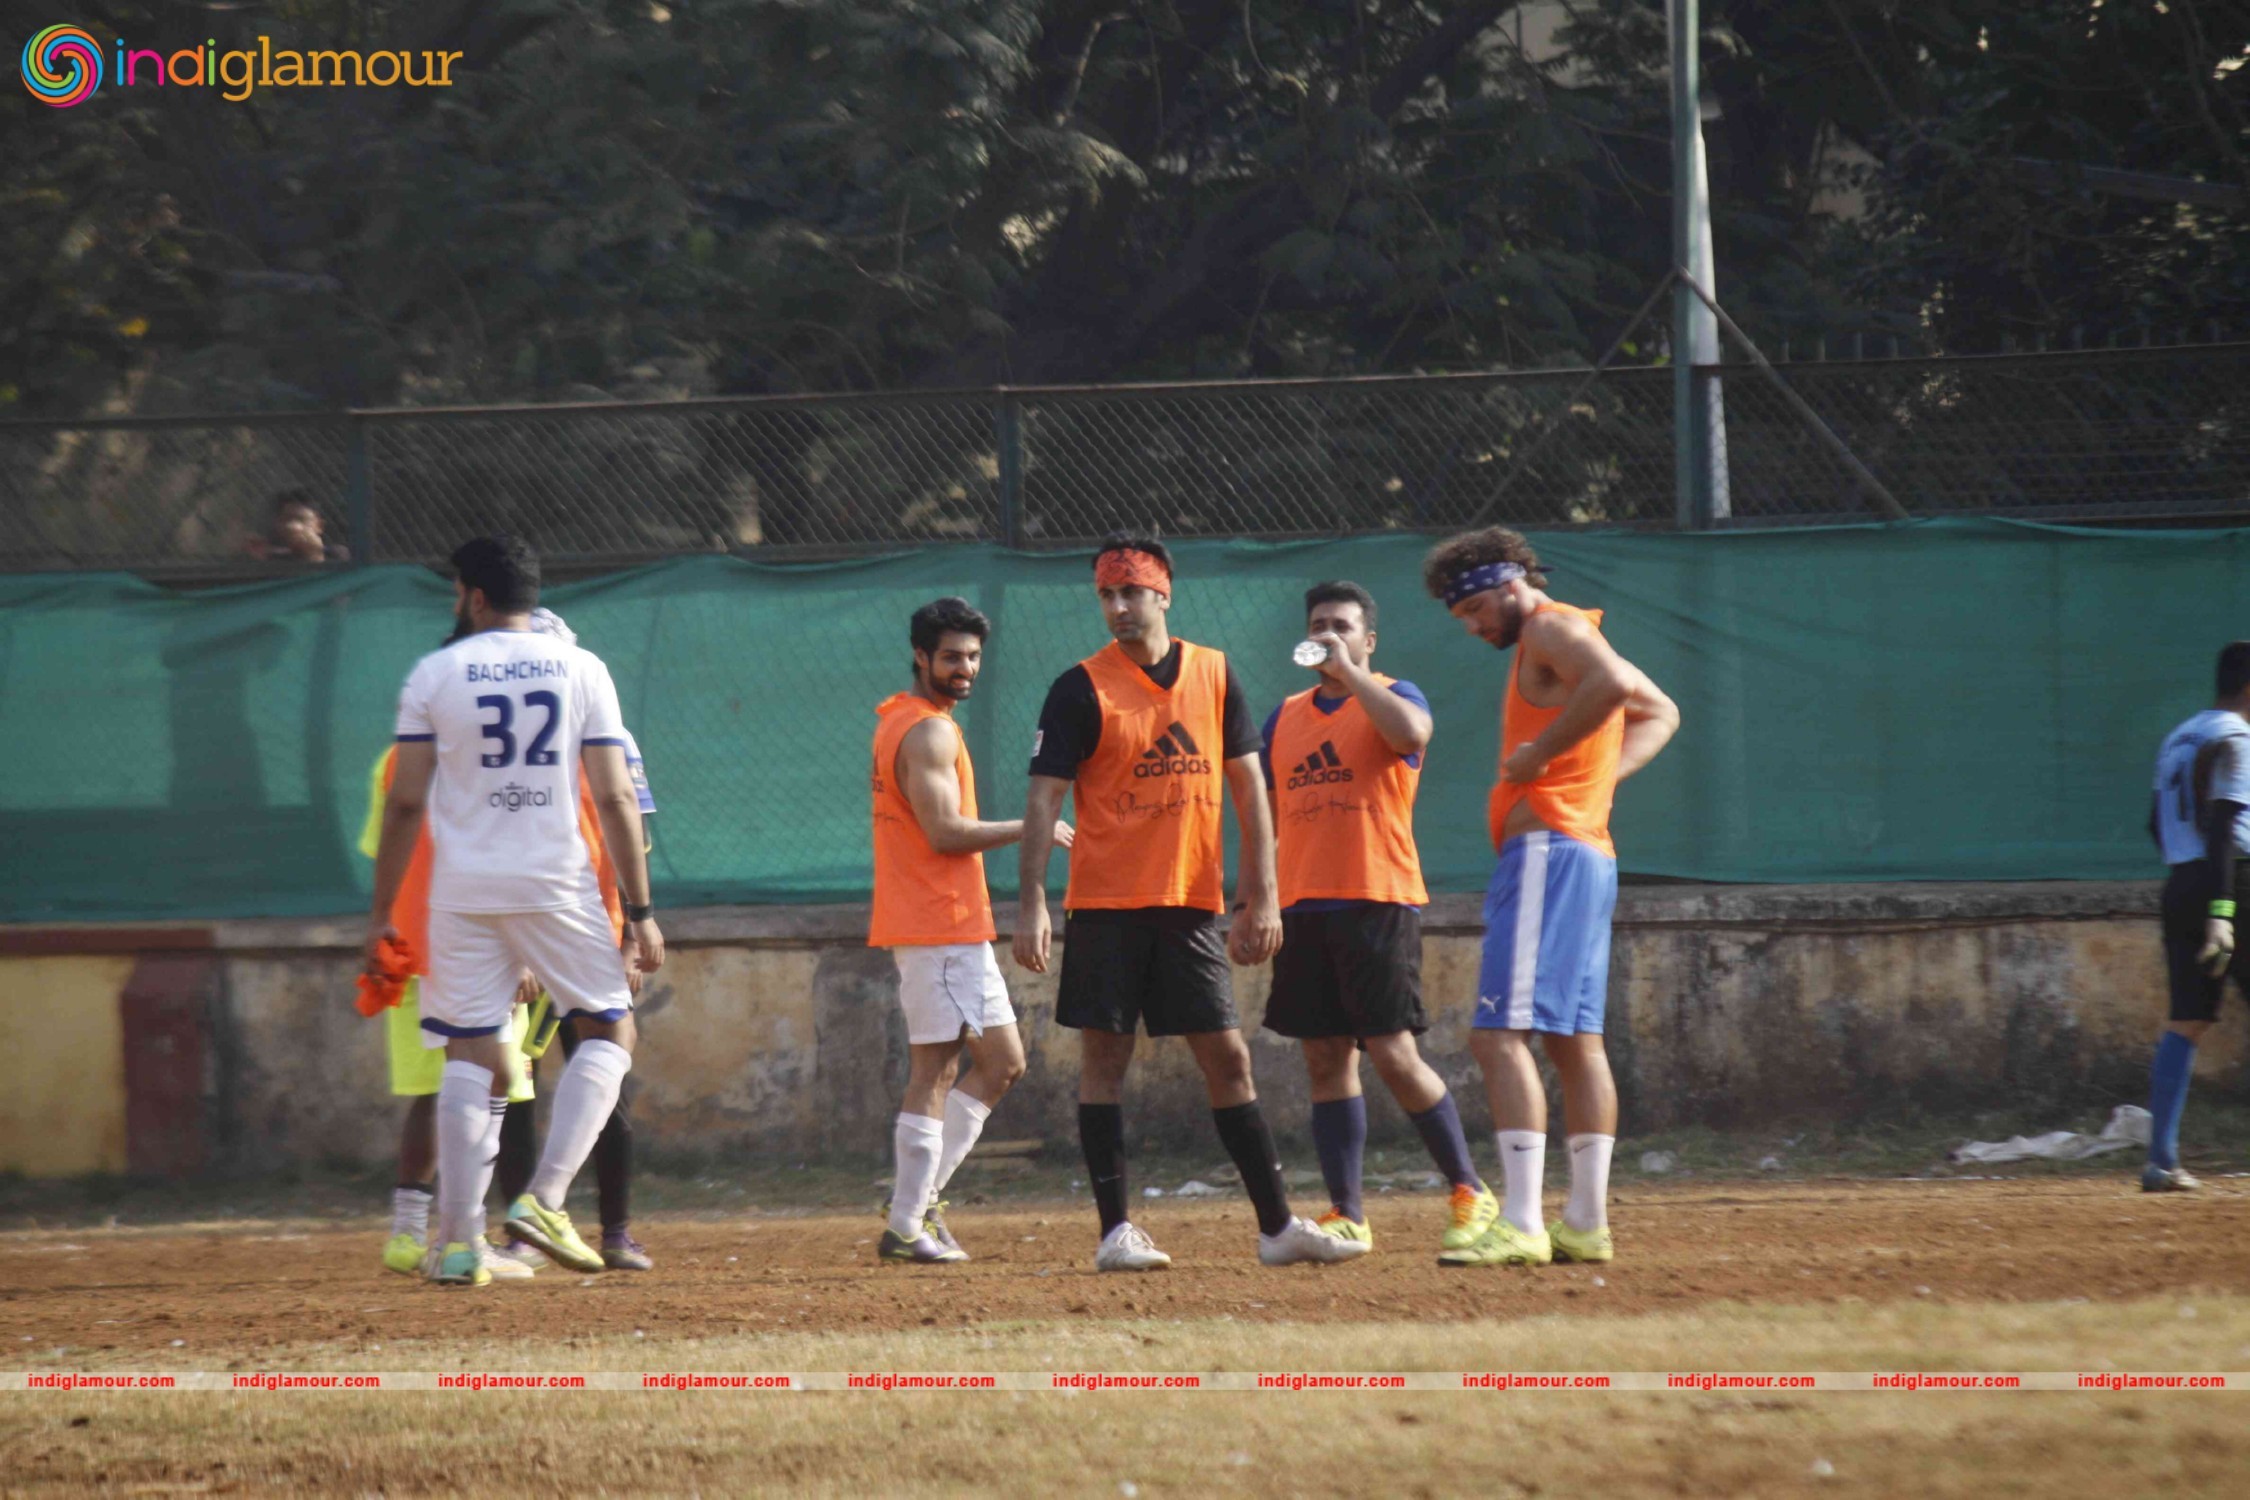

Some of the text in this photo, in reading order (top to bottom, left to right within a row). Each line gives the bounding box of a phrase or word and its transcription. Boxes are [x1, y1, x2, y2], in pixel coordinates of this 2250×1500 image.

[467, 660, 568, 683] BACHCHAN
[476, 690, 561, 768] 32
[1133, 756, 1211, 778] adidas
[1286, 768, 1354, 790] adidas
[489, 785, 552, 812] digital
